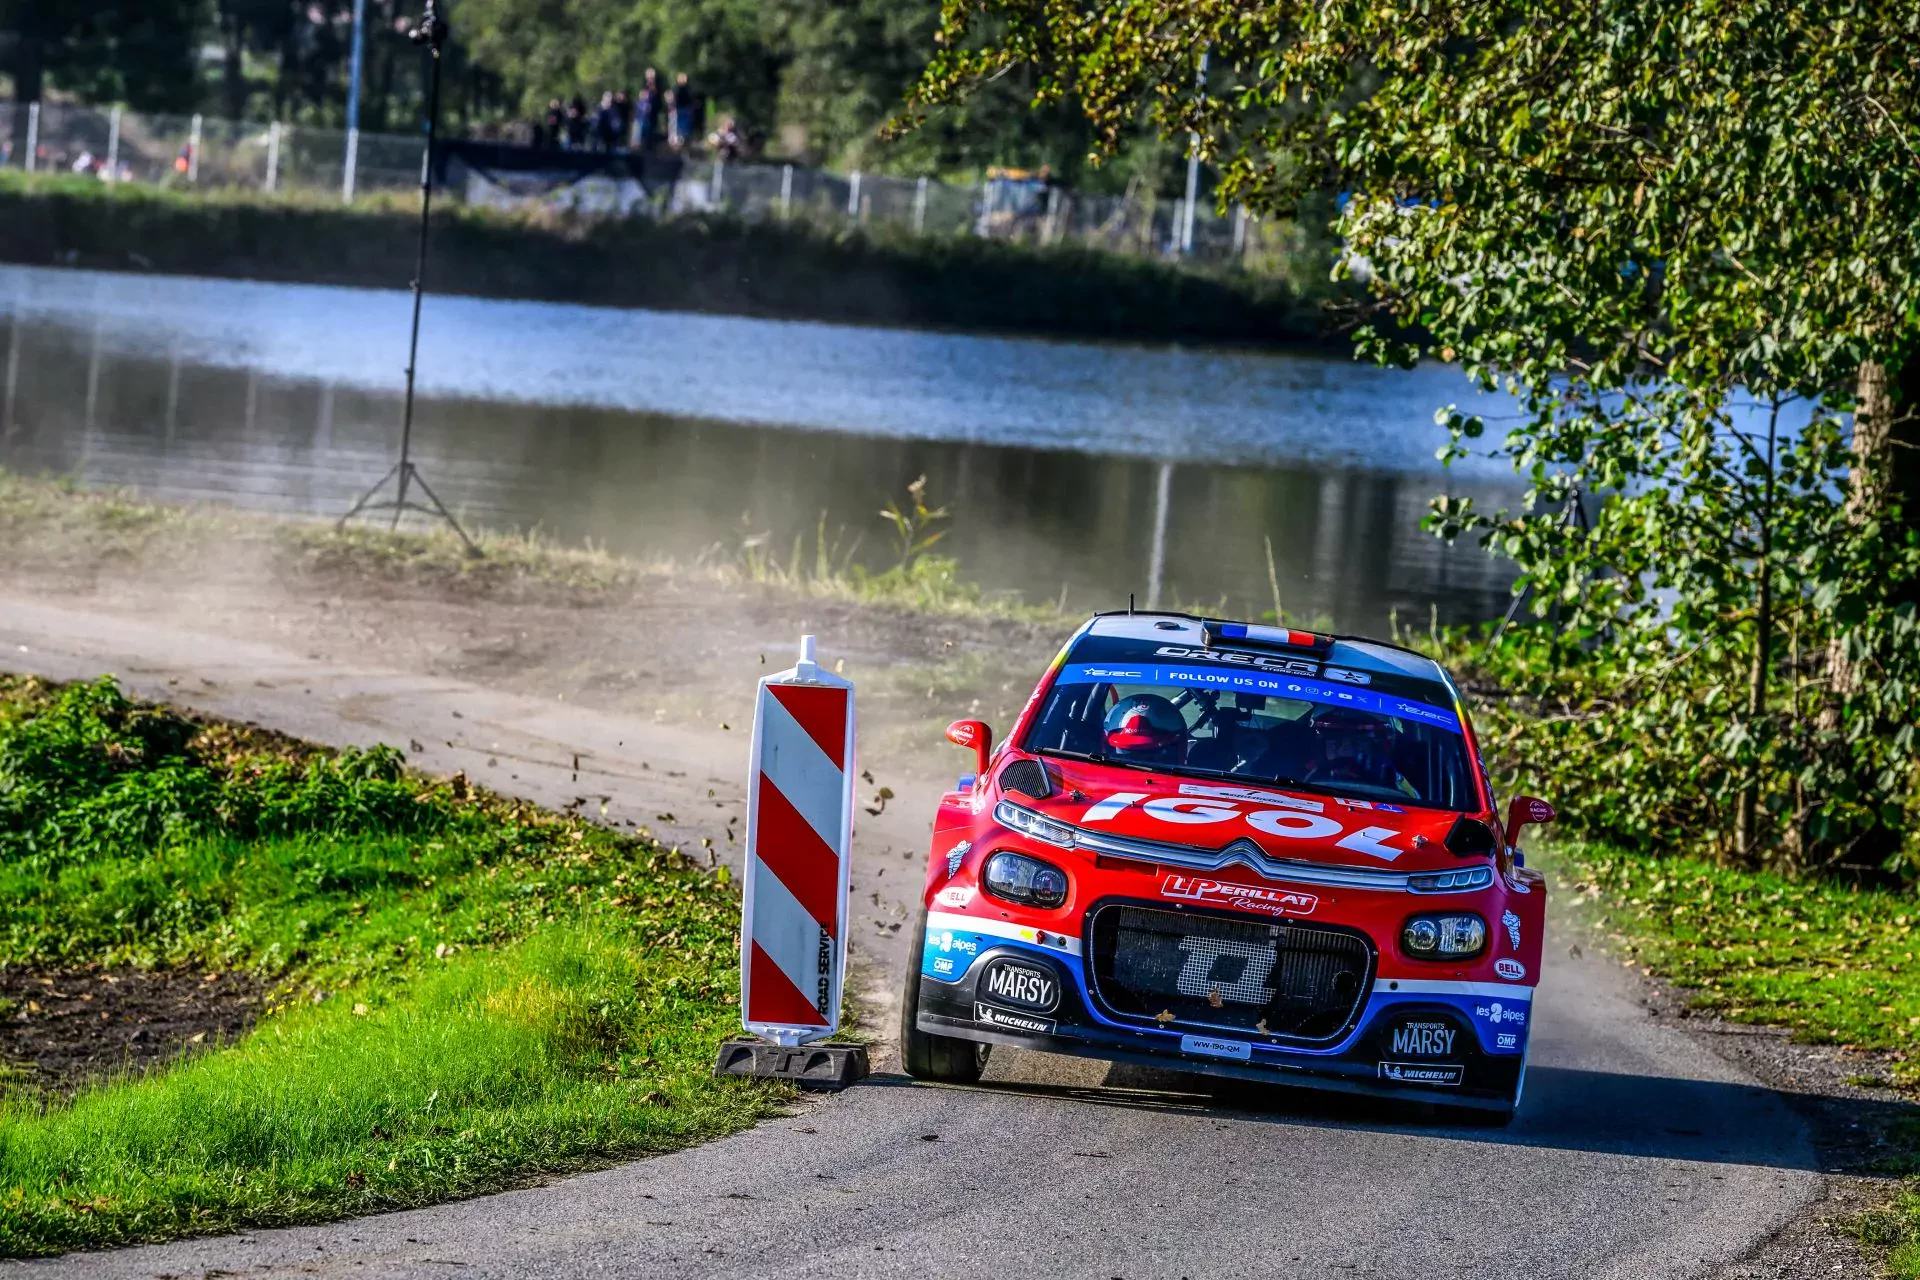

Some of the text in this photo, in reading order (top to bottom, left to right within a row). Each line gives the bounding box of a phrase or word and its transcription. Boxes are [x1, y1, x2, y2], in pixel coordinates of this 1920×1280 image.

[1153, 646, 1318, 673] ORECA
[1169, 672, 1279, 689] FOLLOW US ON
[1080, 792, 1404, 862] IGOL
[1228, 896, 1285, 916] Racing
[952, 938, 977, 952] alpes
[817, 920, 831, 1016] ROAD SERVICE
[934, 959, 953, 972] OMP
[1003, 963, 1042, 979] TRANSPORTS
[1498, 962, 1522, 975] BELL
[988, 967, 1052, 1005] MARSY
[1476, 1003, 1525, 1023] les 2 alpes
[994, 1013, 1048, 1033] MICHELIN
[1406, 1022, 1445, 1030] TRANSPORTS
[1193, 1040, 1240, 1053] WW-190-QM
[1392, 1028, 1457, 1055] MARSY
[1497, 1035, 1516, 1047] OMP
[1403, 1070, 1457, 1080] MICHELIN
